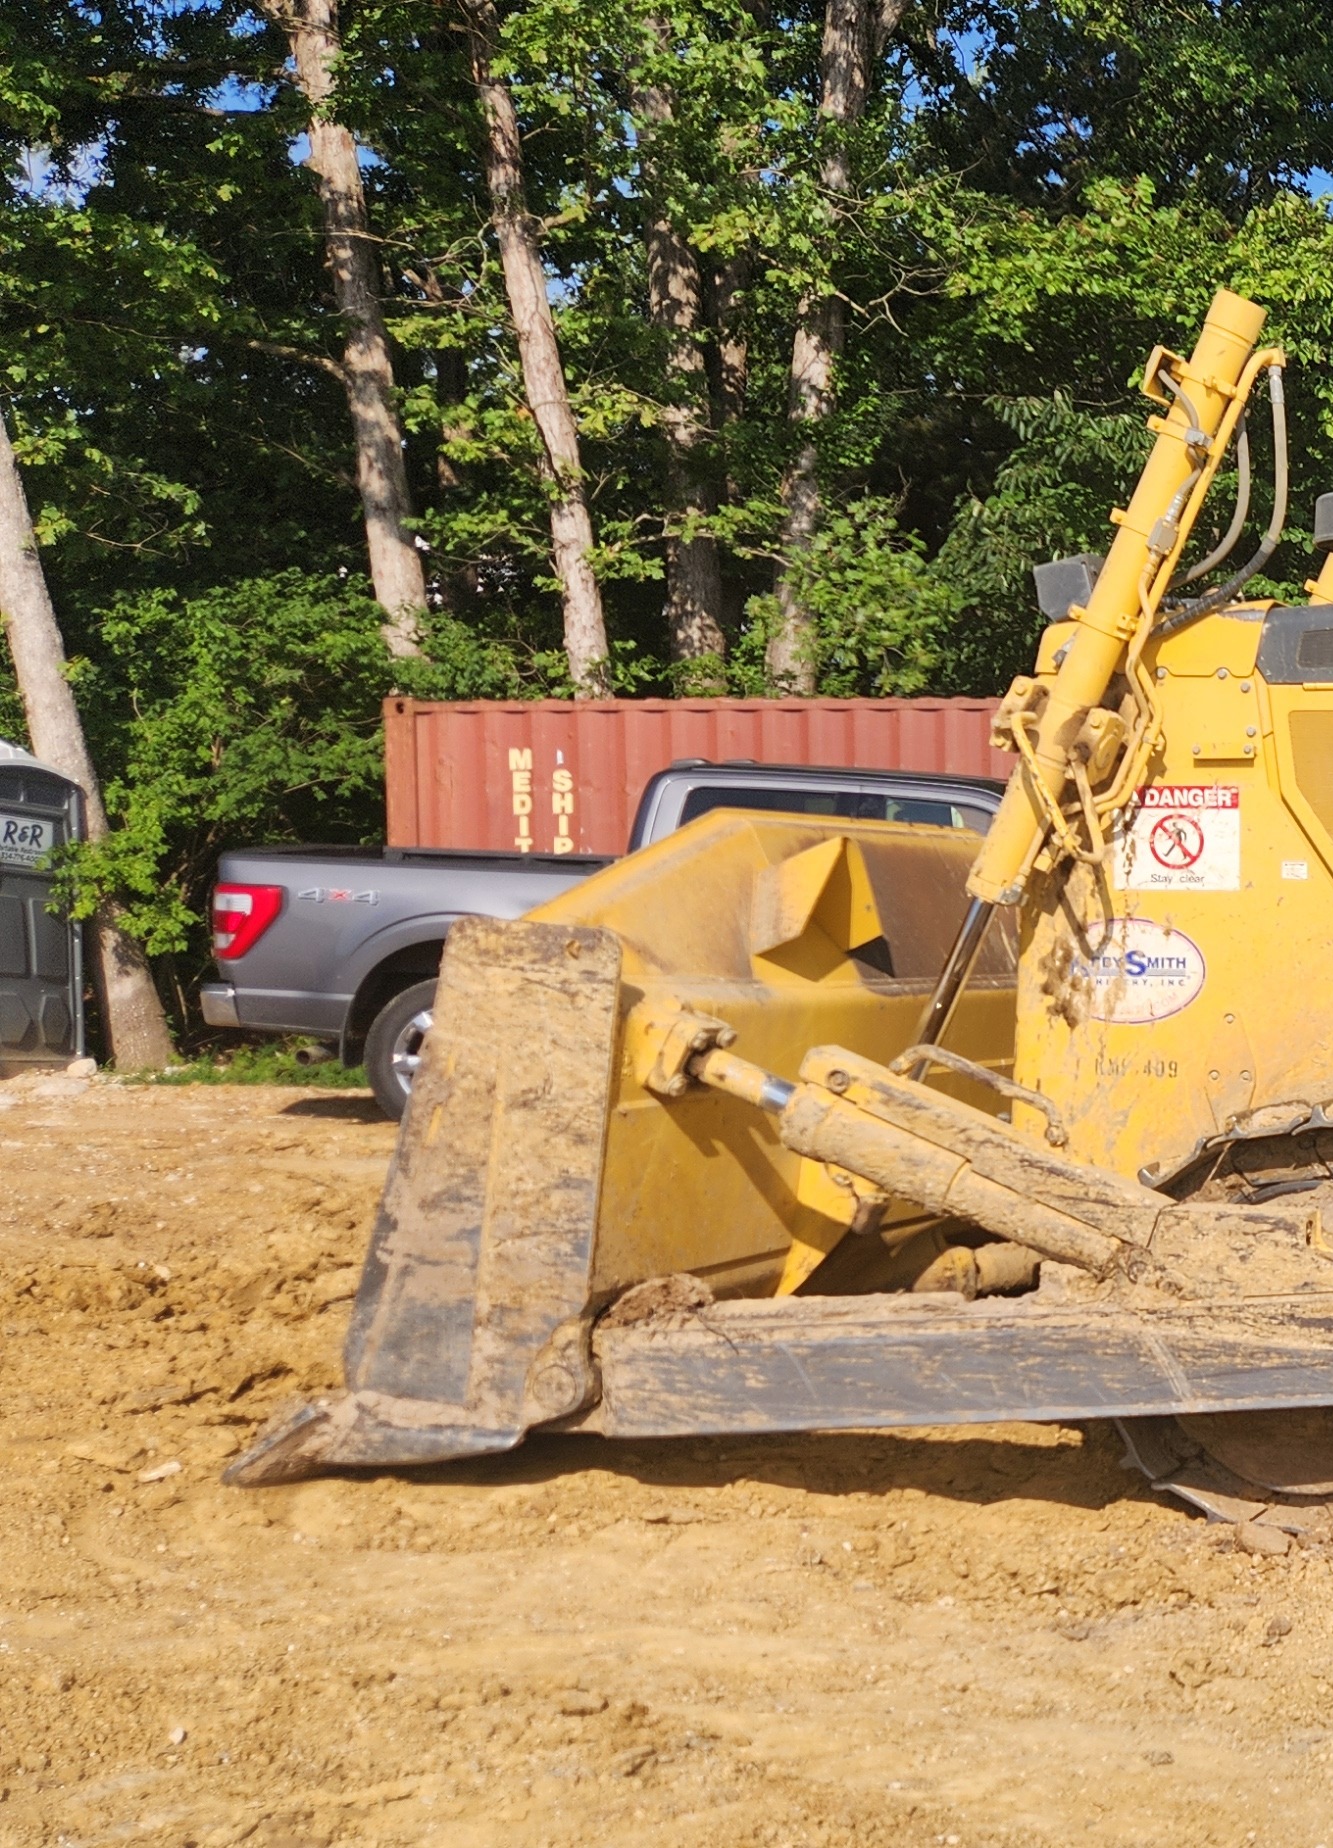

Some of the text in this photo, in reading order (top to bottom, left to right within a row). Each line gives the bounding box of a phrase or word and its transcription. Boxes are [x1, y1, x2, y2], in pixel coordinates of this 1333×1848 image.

[1144, 788, 1232, 807] DANGER
[3, 820, 44, 849] R&R
[1150, 873, 1205, 884] Stay clear
